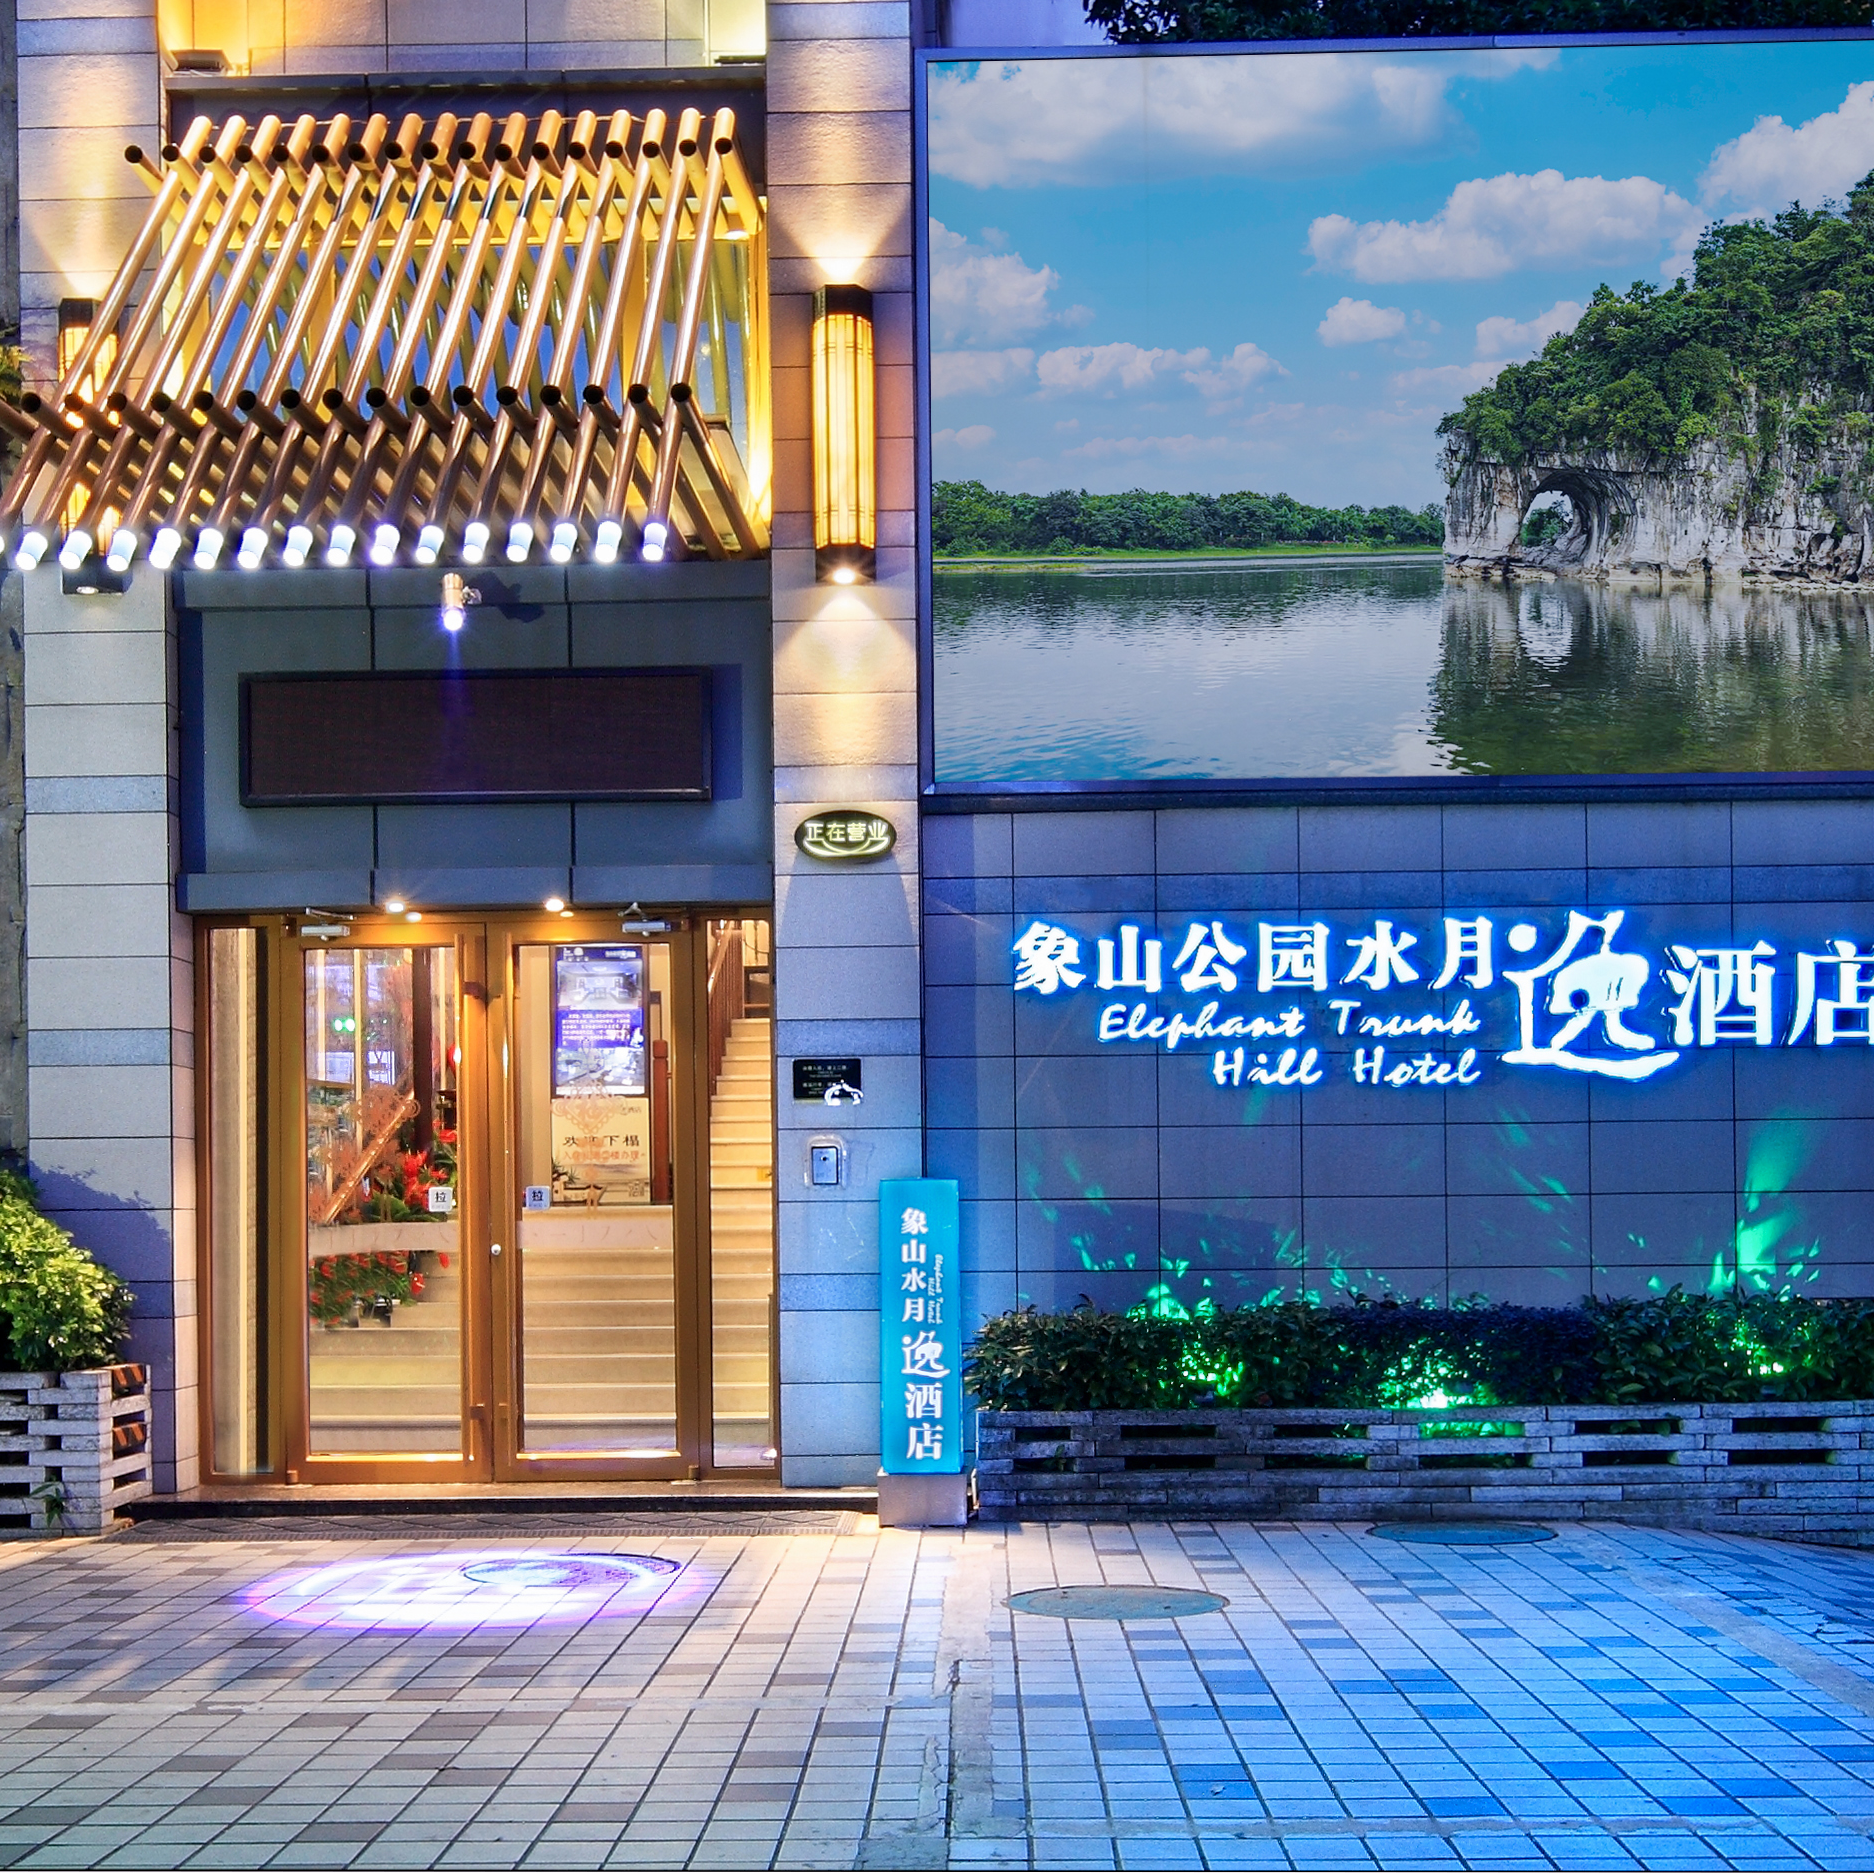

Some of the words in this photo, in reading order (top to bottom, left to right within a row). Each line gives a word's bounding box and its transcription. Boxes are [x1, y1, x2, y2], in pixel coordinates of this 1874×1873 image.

[804, 820, 890, 843] 正在营业
[1097, 1000, 1306, 1049] Elephant
[1329, 999, 1481, 1037] Trunk
[1212, 1046, 1324, 1086] Hill
[1352, 1045, 1482, 1087] Hotel
[434, 1191, 447, 1203] 拉
[531, 1190, 544, 1202] 拉
